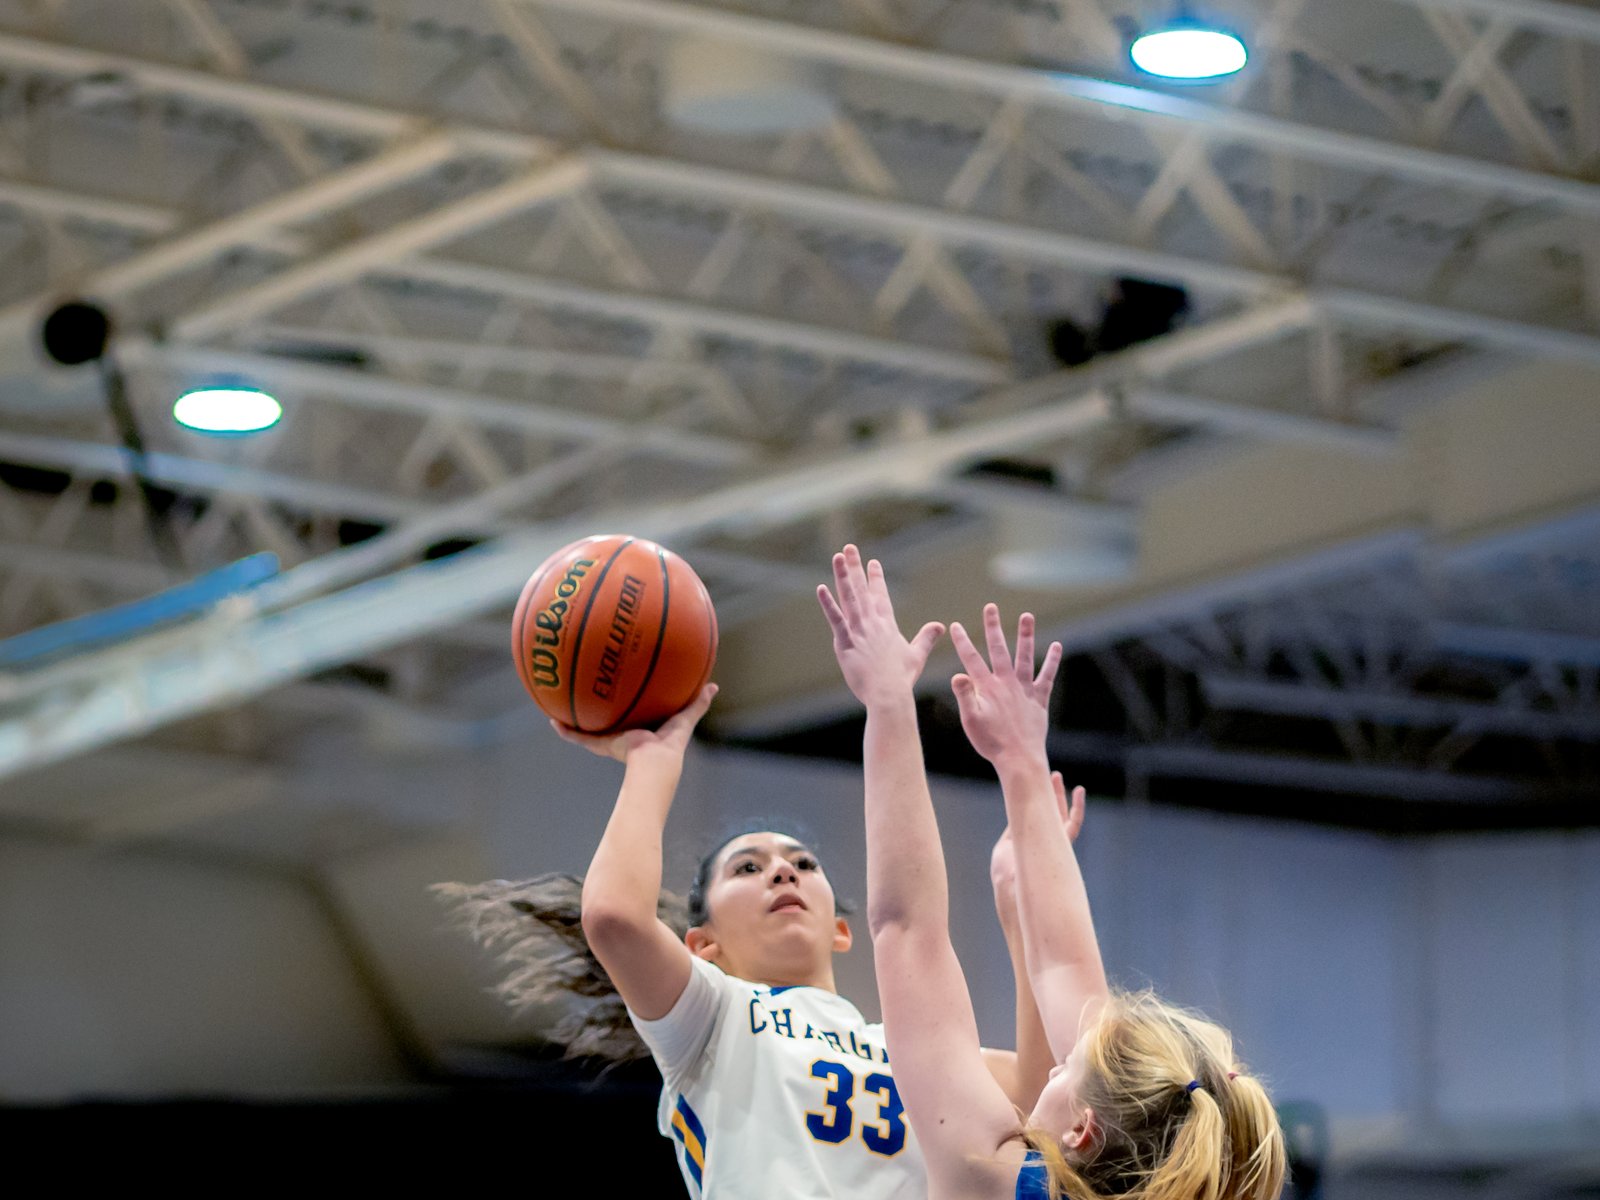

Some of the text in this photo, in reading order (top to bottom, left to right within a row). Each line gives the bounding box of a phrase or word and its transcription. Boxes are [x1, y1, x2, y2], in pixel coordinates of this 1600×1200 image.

[532, 558, 597, 689] Wilson
[592, 574, 641, 700] EVOLUTION
[750, 998, 890, 1063] CHARG
[804, 1059, 907, 1159] 33
